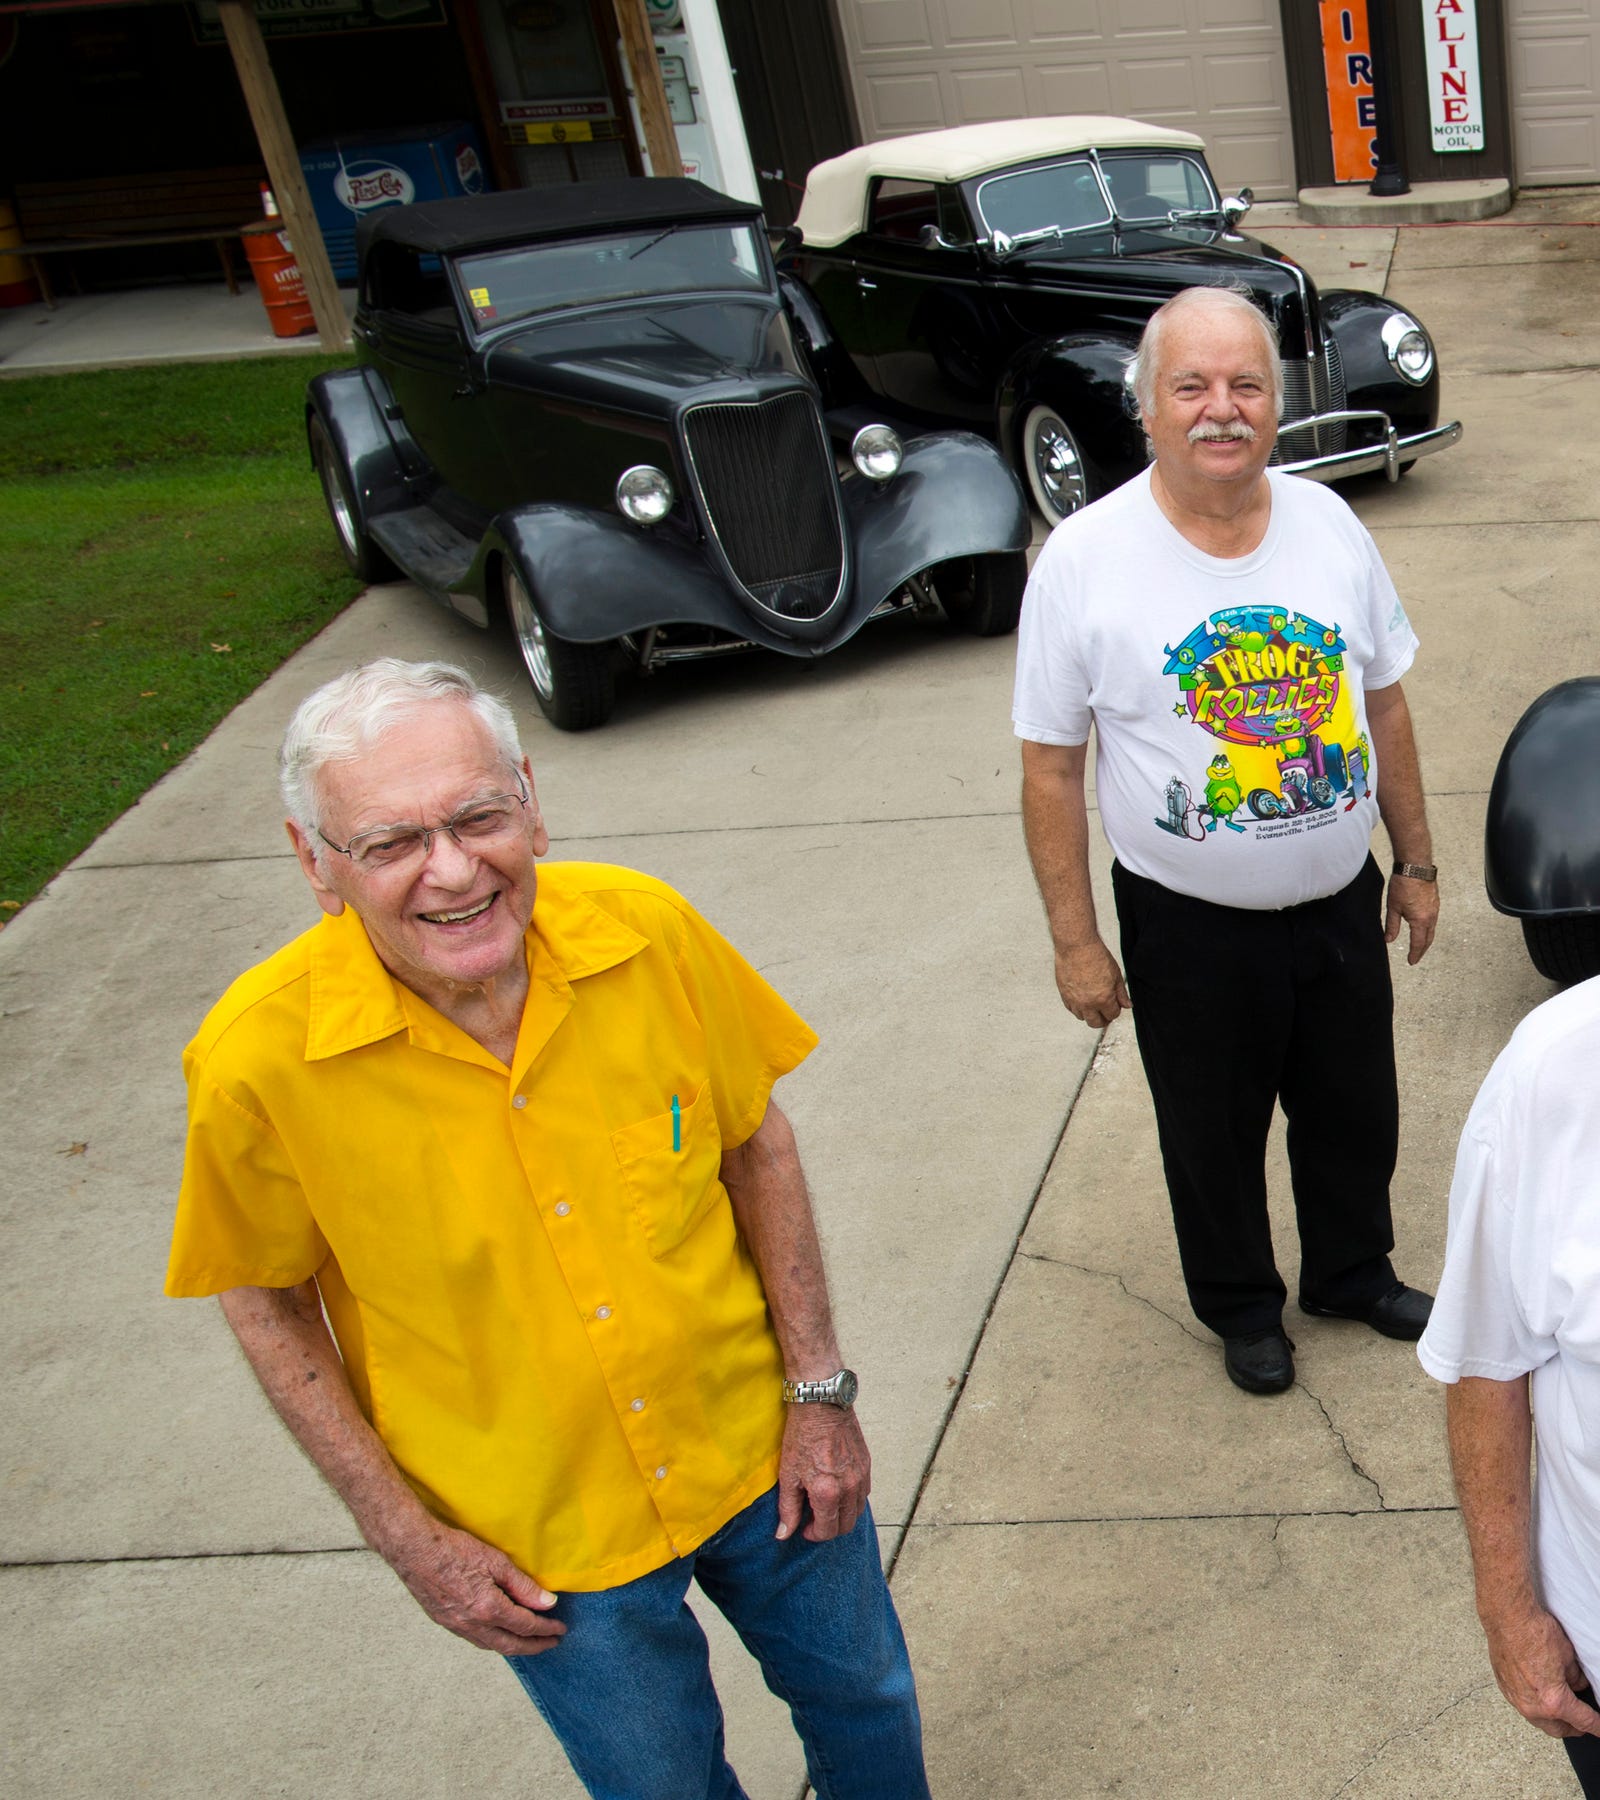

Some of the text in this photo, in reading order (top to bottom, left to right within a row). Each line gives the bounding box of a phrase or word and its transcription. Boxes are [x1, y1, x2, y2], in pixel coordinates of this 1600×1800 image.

[1435, 0, 1469, 123] ALINE
[1434, 125, 1481, 135] MOTOR
[1447, 137, 1469, 146] OIL
[1210, 642, 1314, 689] FROG
[1192, 675, 1337, 723] FOLLIES
[1256, 823, 1289, 833] August
[1307, 817, 1338, 831] Indiana
